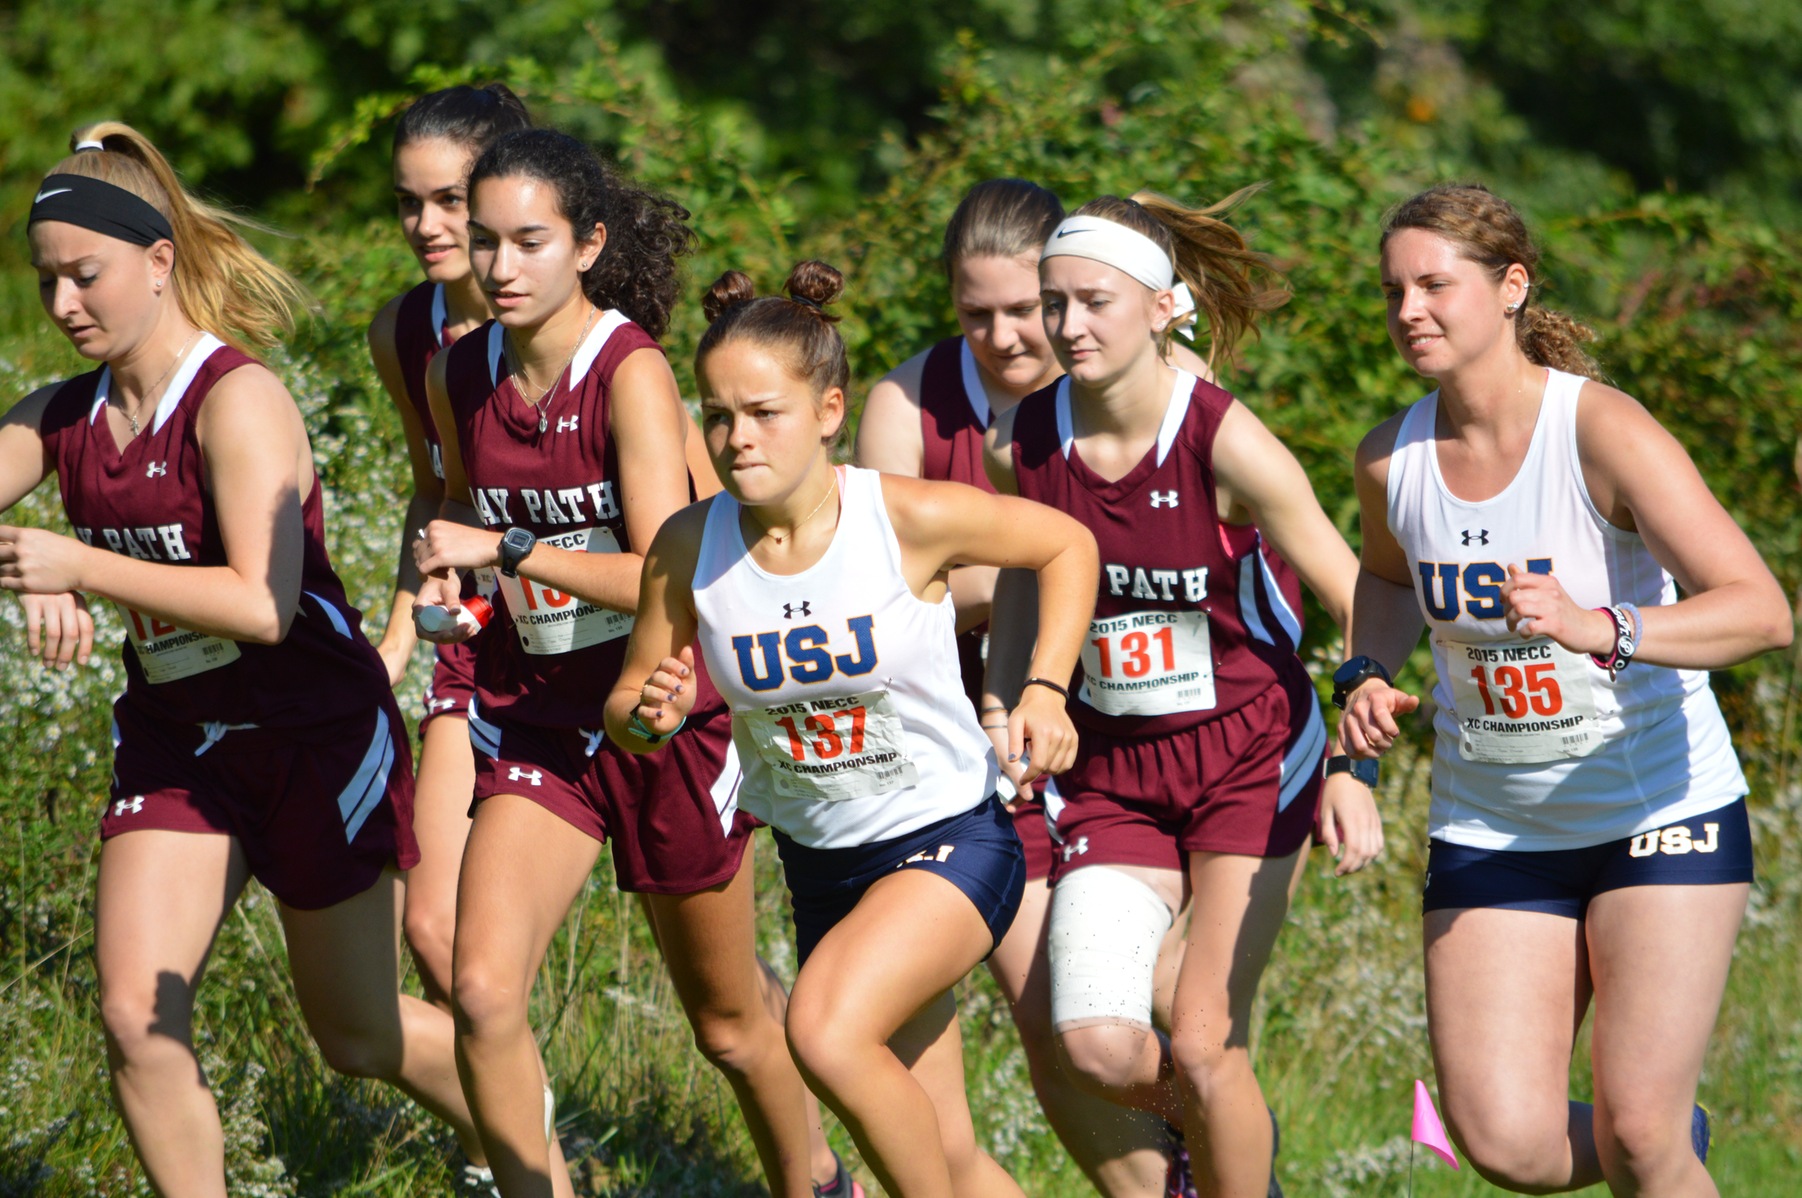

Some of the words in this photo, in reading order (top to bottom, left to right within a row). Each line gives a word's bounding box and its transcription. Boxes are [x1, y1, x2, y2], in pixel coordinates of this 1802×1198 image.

[468, 486, 512, 526] AY
[522, 481, 620, 525] PATH
[102, 523, 191, 561] PATH
[1106, 565, 1209, 602] PATH
[517, 615, 528, 625] XC
[529, 603, 603, 625] CHAMPIONS
[1089, 619, 1127, 634] 2015
[1133, 614, 1178, 628] NECC
[732, 614, 878, 692] USJ
[1091, 627, 1175, 679] 131
[1466, 647, 1498, 662] 2015
[1504, 645, 1551, 662] NECC
[1099, 672, 1199, 691] CHAMPIONSHIP
[1471, 662, 1563, 720] 135
[765, 703, 807, 716] 2015
[811, 696, 860, 712] NECC
[774, 705, 867, 762] 137
[1467, 717, 1481, 729] XC
[1483, 715, 1584, 733] CHAMPIONSHIP
[778, 759, 792, 772] XC
[794, 752, 897, 774] CHAMPIONSHIP
[1629, 823, 1719, 858] USJ
